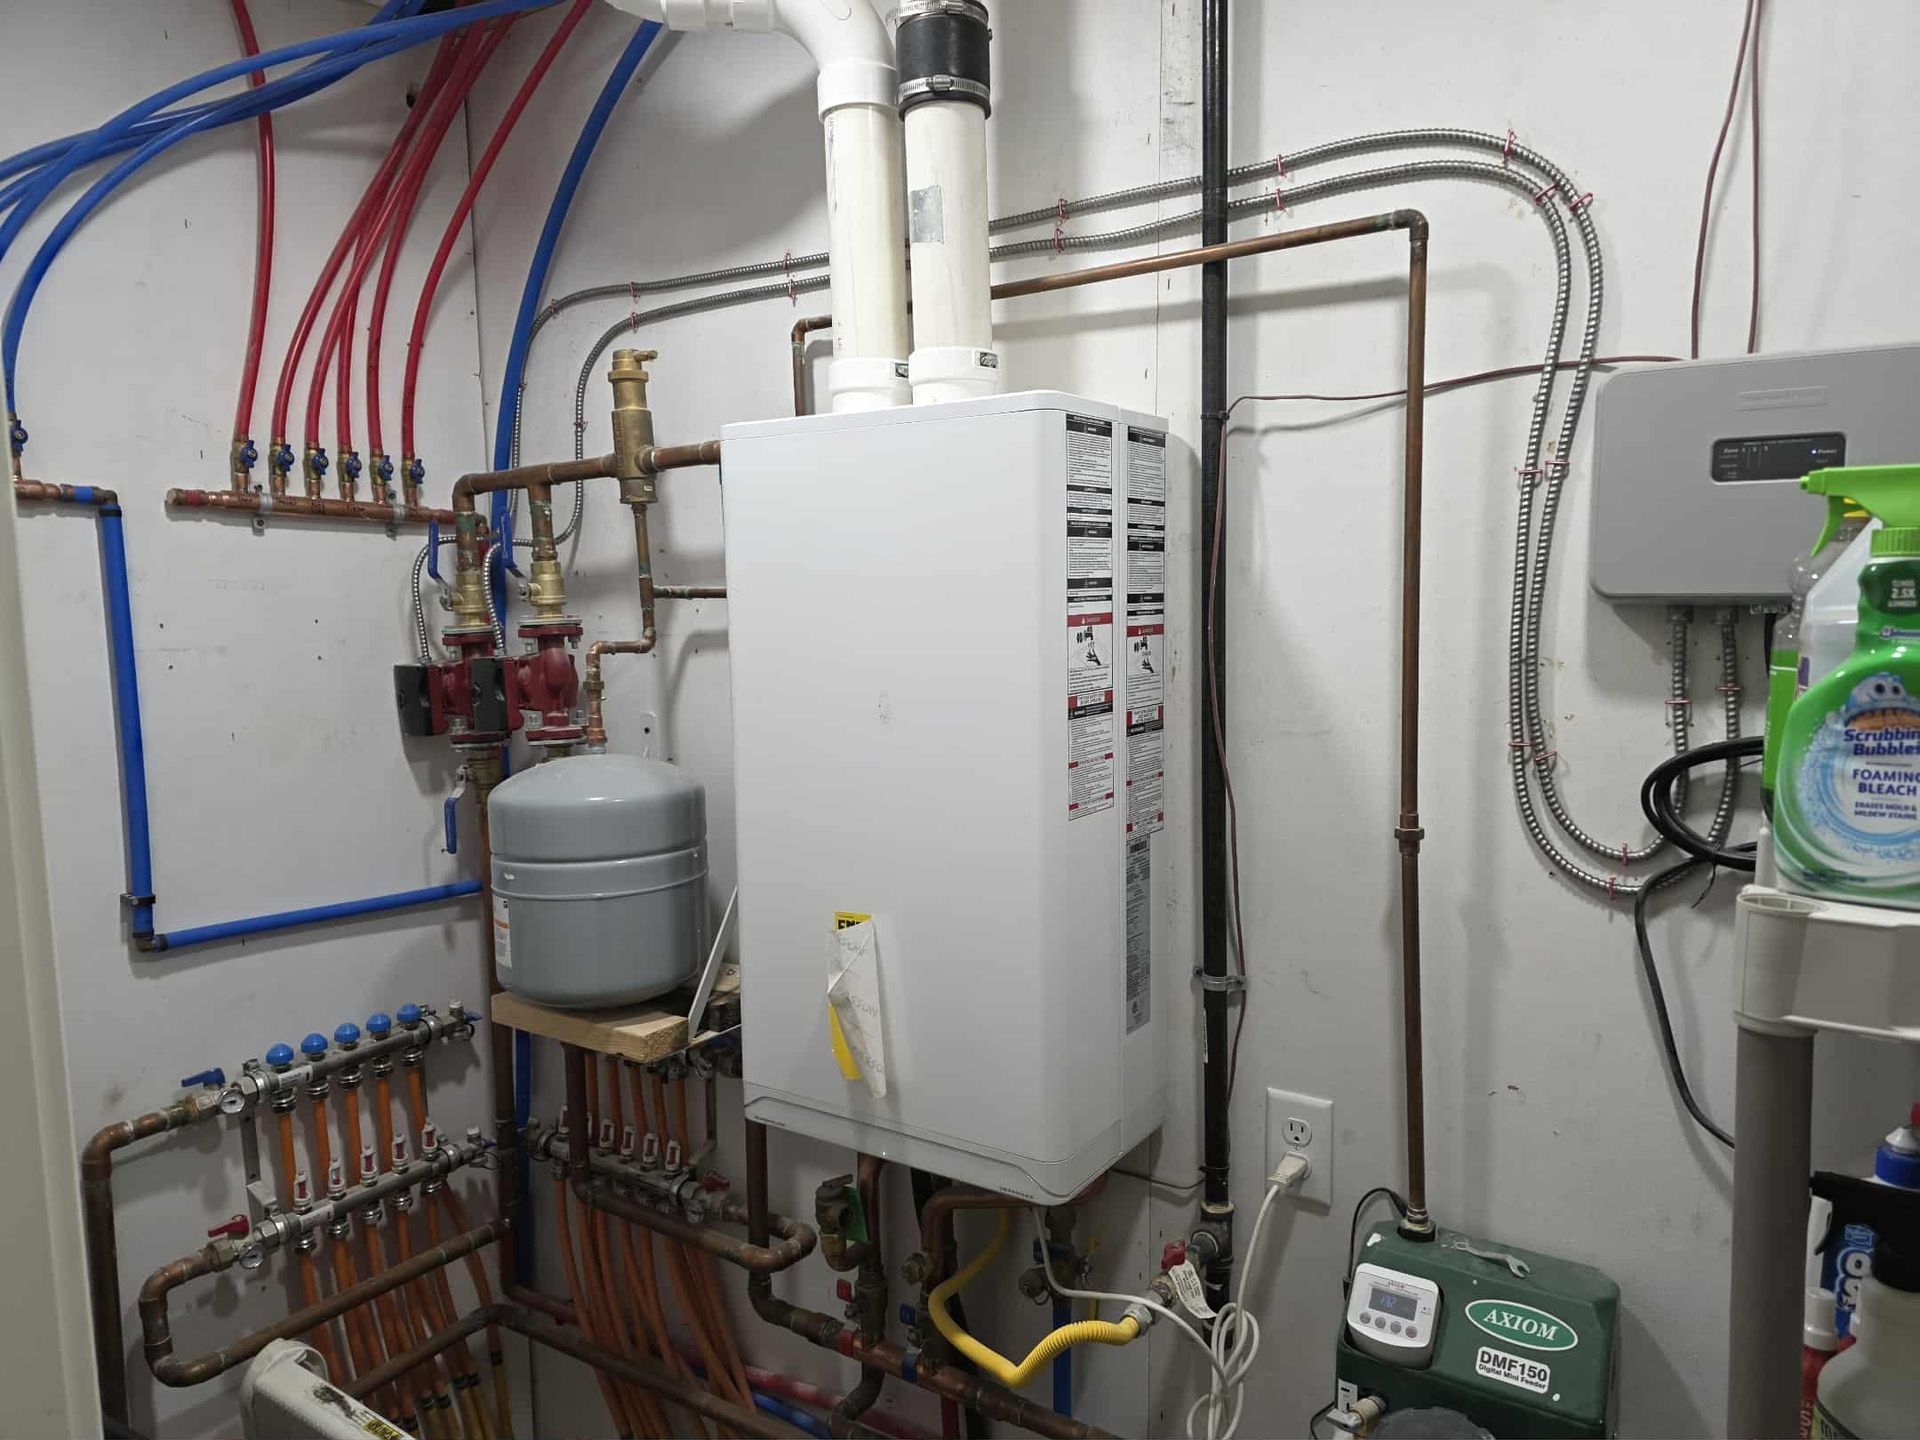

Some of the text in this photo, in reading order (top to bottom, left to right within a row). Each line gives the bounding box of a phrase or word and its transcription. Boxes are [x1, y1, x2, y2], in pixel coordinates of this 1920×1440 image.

[1858, 782, 1917, 796] BLEACH
[1854, 810, 1887, 818] MILDEW
[1483, 1309, 1558, 1341] AXIOM
[1478, 1363, 1547, 1390] Digital Mini Feeder
[1480, 1350, 1548, 1382] DMF150
